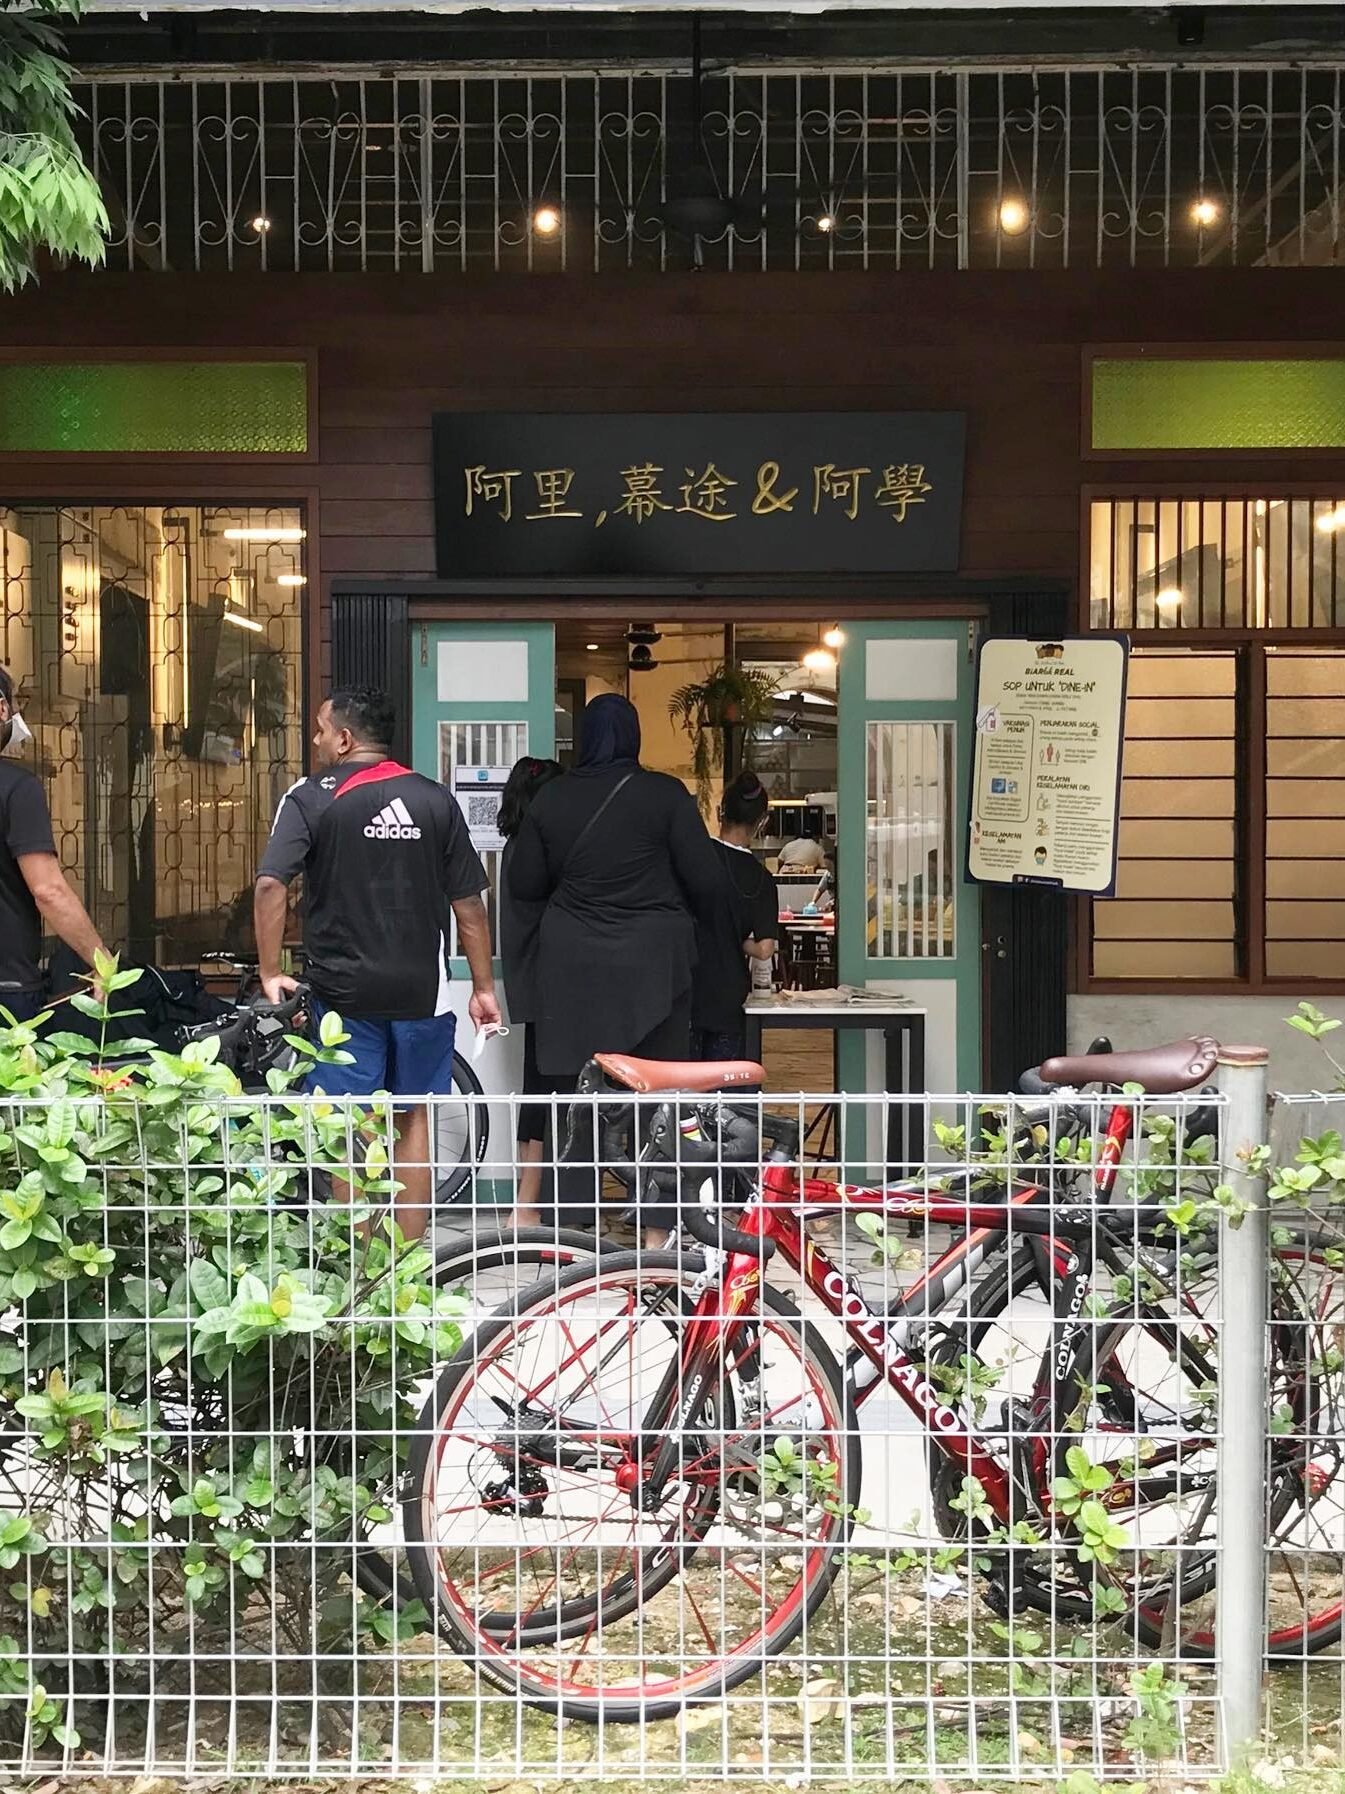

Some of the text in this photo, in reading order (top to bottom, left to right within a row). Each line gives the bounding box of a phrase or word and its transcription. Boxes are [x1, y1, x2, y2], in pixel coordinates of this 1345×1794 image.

[1054, 668, 1074, 676] REAL
[1003, 681, 1022, 691] SOP
[1025, 681, 1055, 692] UNTUK
[363, 823, 422, 840] adidas
[823, 1271, 961, 1431] COLNAGO
